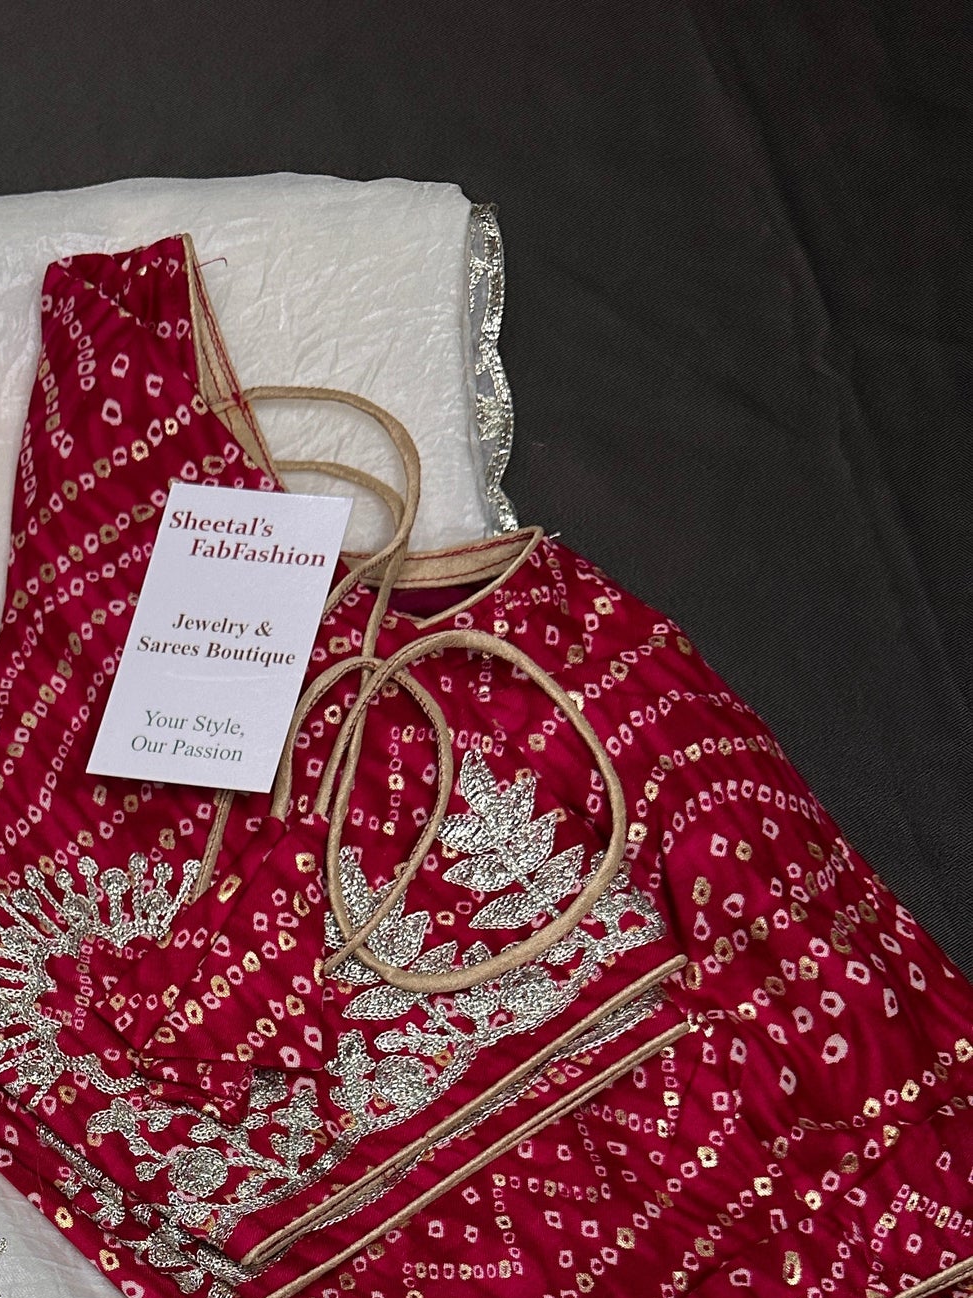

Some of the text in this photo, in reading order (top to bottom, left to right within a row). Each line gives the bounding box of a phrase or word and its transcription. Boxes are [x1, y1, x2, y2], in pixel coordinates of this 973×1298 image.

[169, 510, 274, 537] Sheetal’s
[189, 538, 326, 567] FabFashion
[172, 613, 273, 638] Jewelry &
[137, 636, 296, 668] Sarees Boutique
[145, 710, 246, 737] Your Style,
[131, 735, 243, 762] Our Passion
